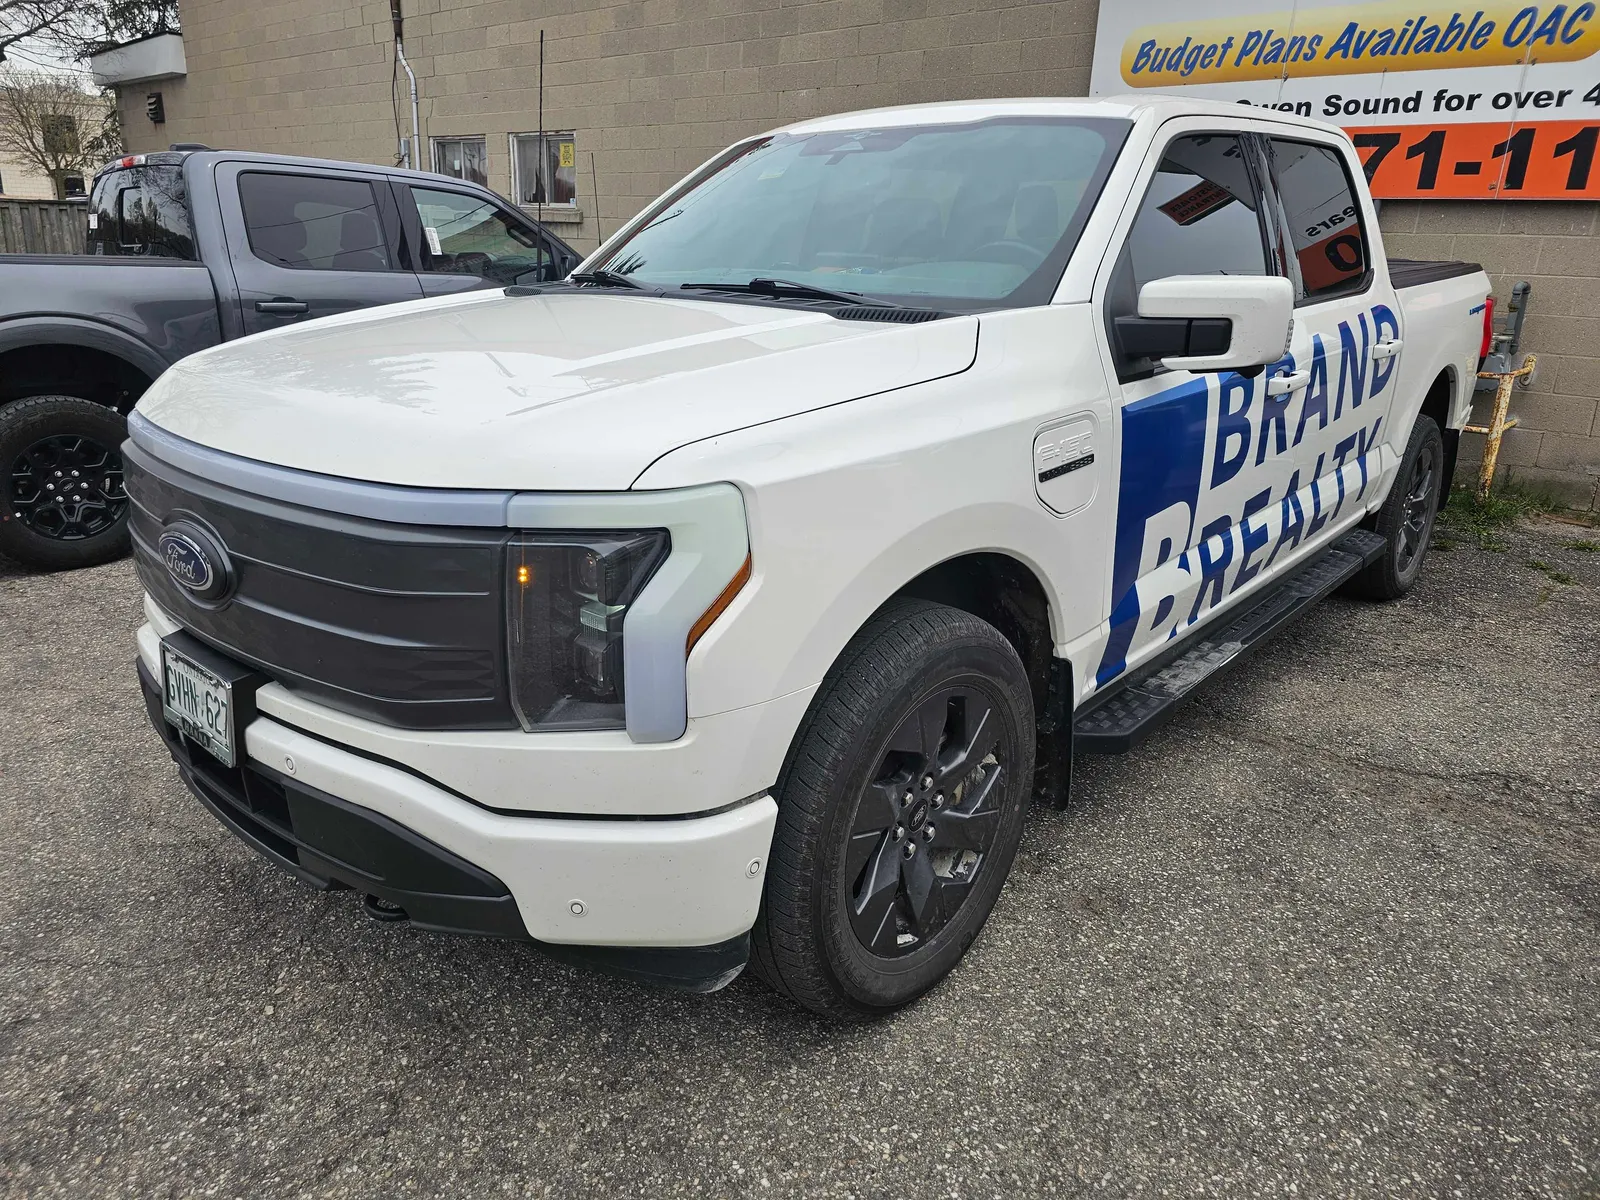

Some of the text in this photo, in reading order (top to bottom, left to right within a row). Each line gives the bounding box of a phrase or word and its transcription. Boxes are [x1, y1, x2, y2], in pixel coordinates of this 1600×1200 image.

[1130, 2, 1596, 77] Budget Plans Available OAC
[1322, 90, 1423, 117] Sound
[1433, 88, 1482, 112] for
[1491, 89, 1574, 110] over
[1210, 304, 1399, 490] BRAND
[1187, 416, 1382, 626] REALTY
[166, 541, 196, 580] Ford
